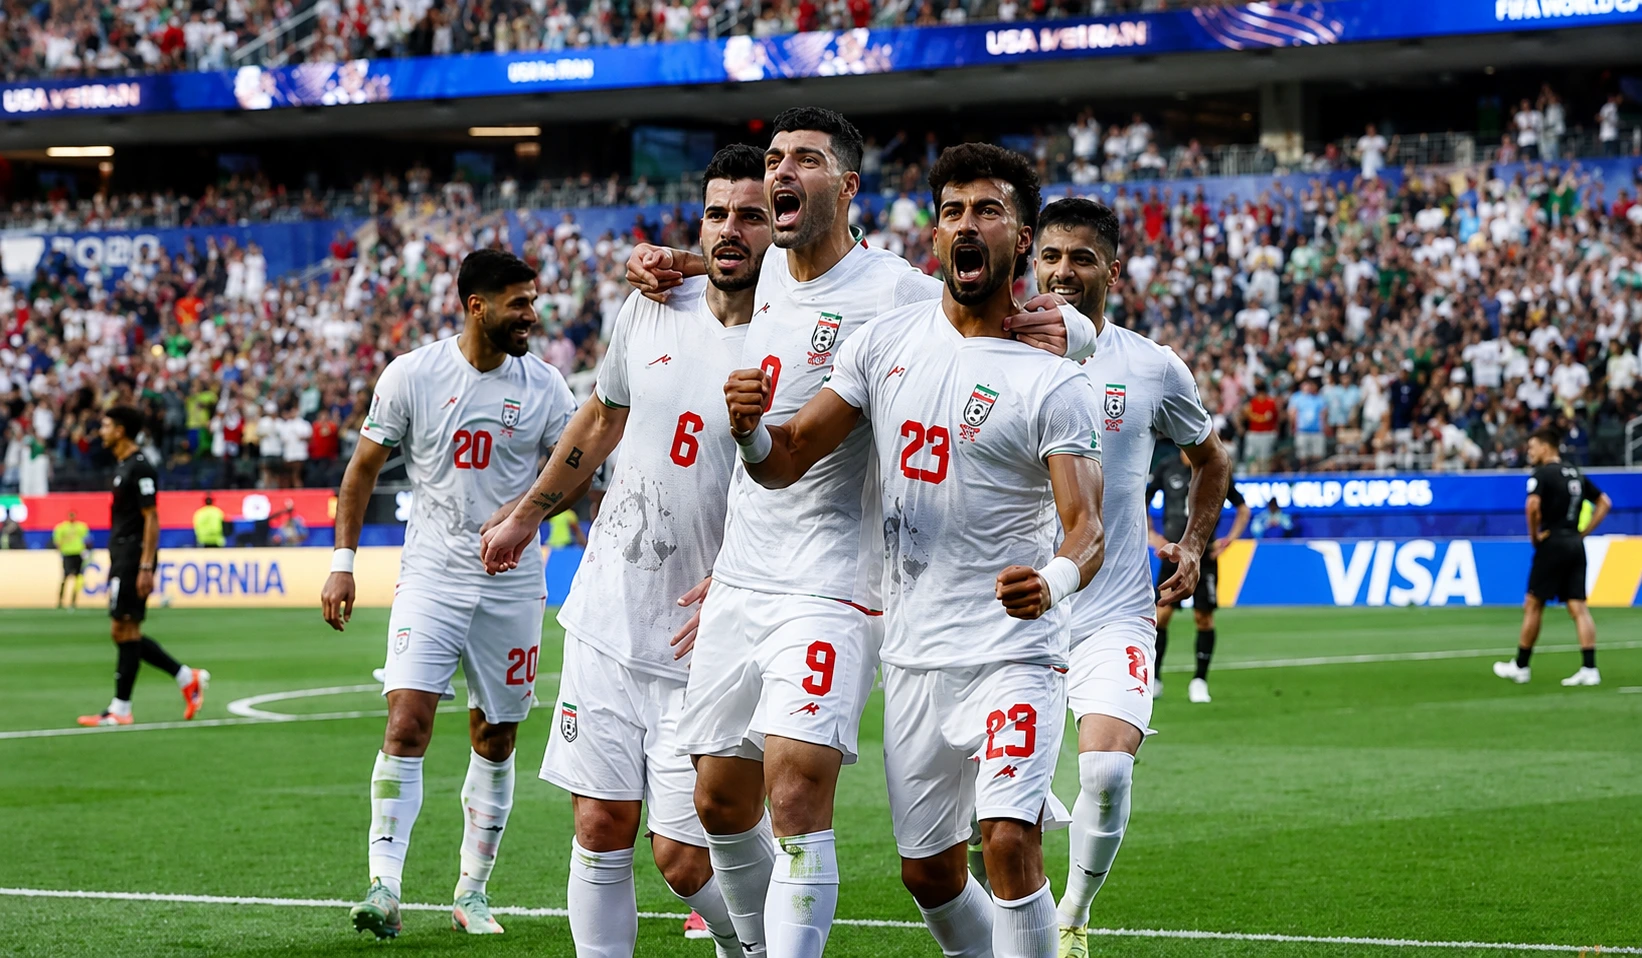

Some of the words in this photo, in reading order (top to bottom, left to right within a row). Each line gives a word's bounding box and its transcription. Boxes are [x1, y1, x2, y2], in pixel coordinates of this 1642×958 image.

[987, 28, 1038, 55] USA
[3, 87, 48, 112] USA
[453, 430, 493, 470] 20
[670, 411, 704, 468] 6
[900, 419, 950, 485] 23
[83, 562, 285, 595] CFORNIA
[1307, 539, 1483, 607] VISA
[507, 645, 538, 685] 20
[802, 640, 836, 697] 9
[986, 703, 1037, 761] 23
